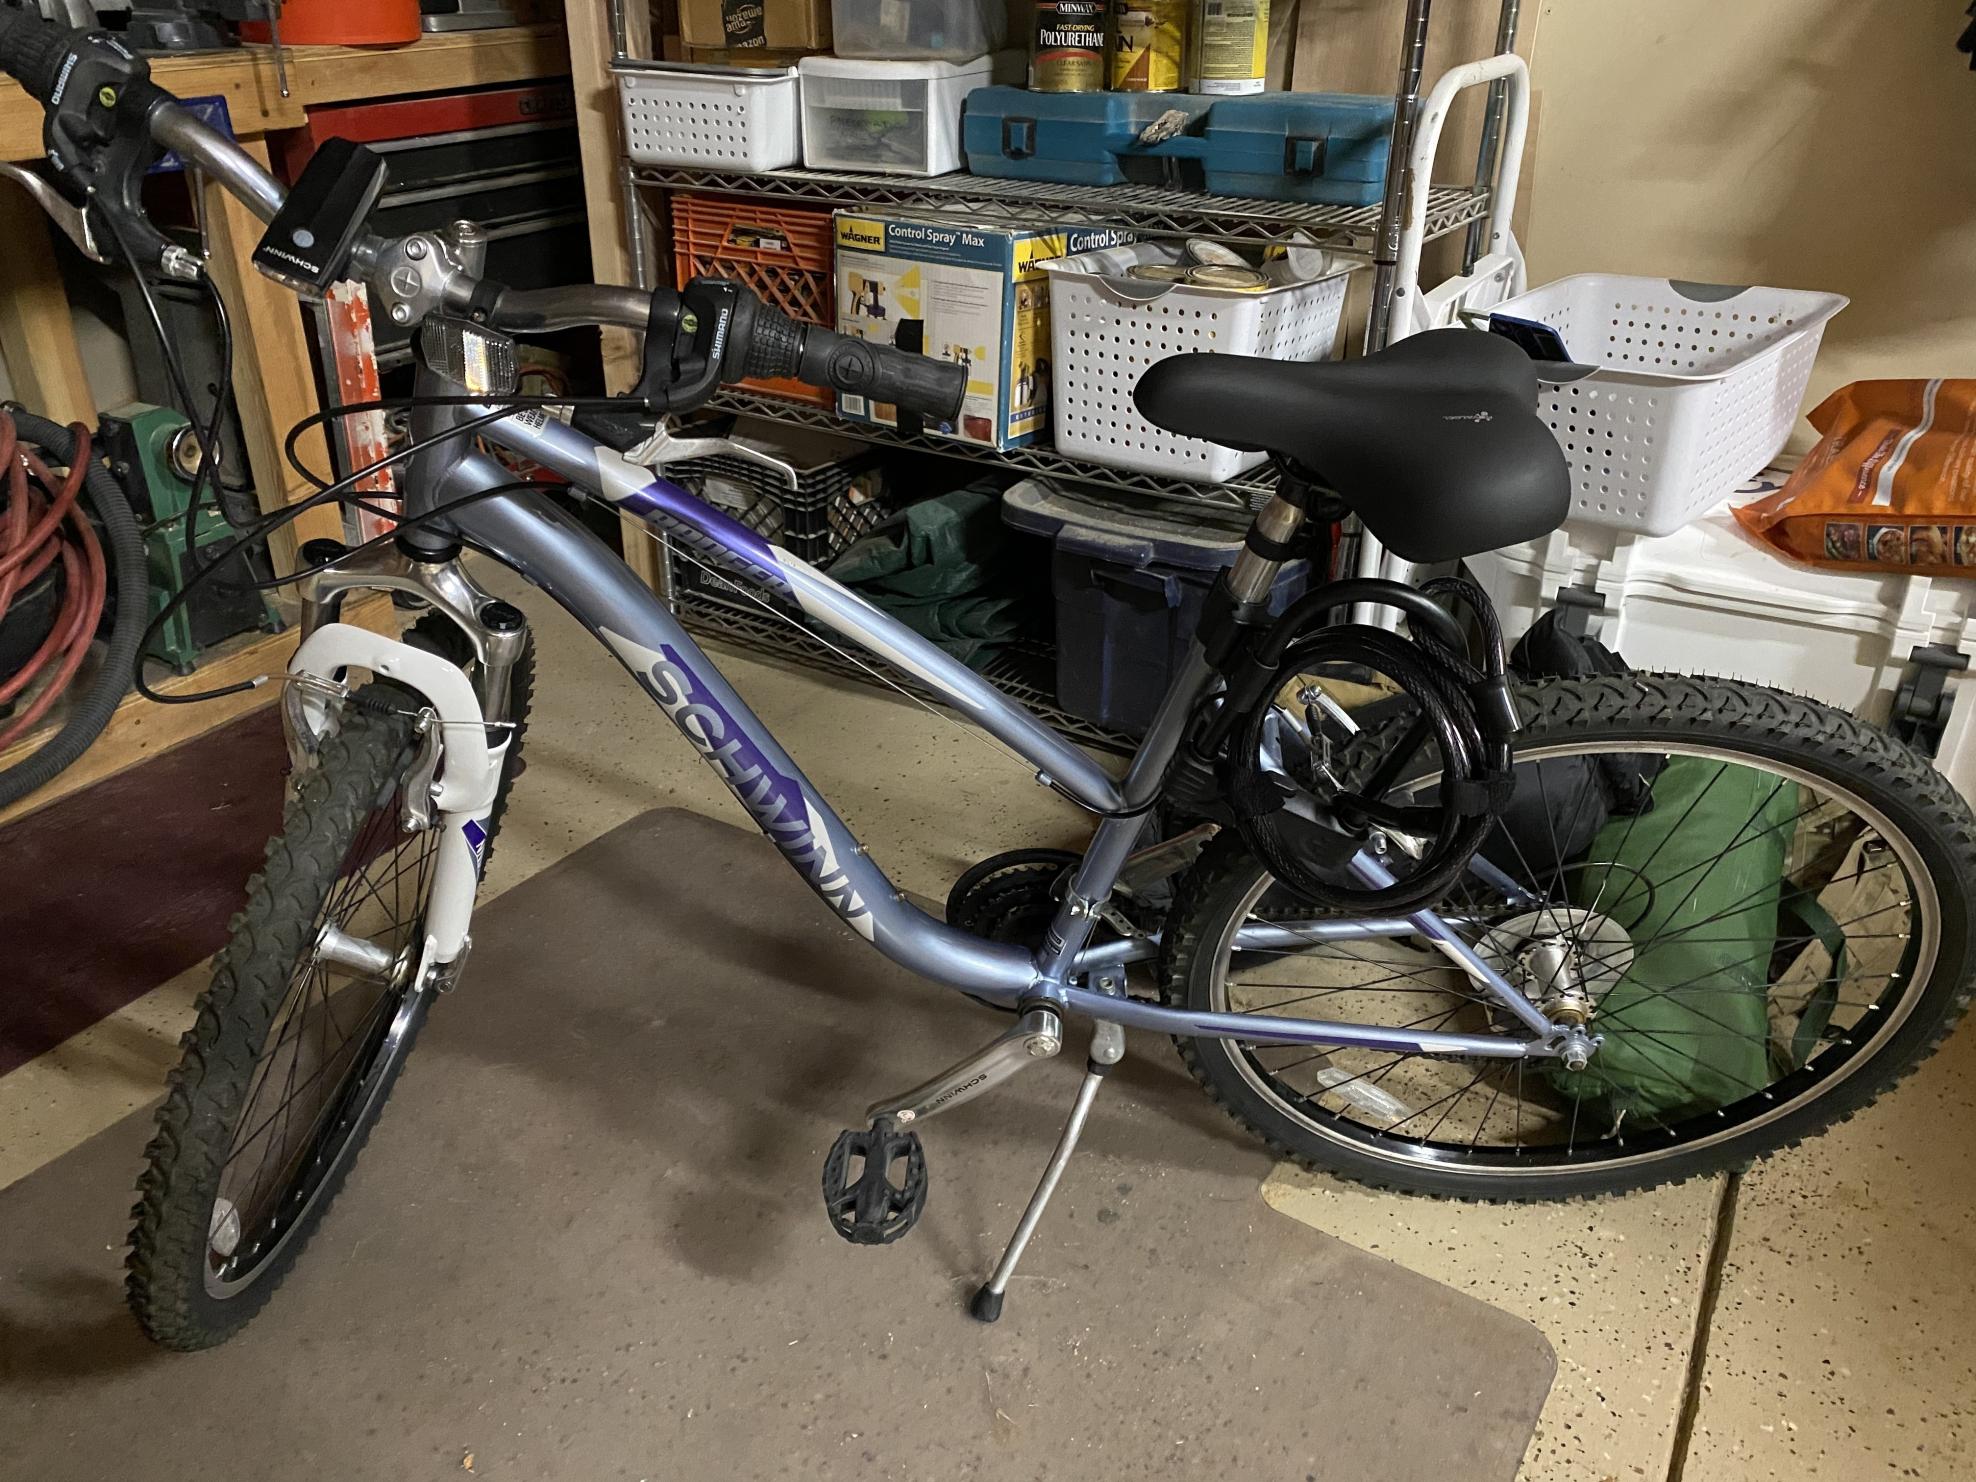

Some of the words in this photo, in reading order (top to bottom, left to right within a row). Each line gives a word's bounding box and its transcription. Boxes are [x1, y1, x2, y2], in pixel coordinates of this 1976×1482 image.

[1059, 3, 1094, 13] MINWAX
[1056, 24, 1095, 32] FAST-DRYING
[51, 52, 78, 105] SHIMANO
[840, 231, 881, 246] WAGNER
[888, 224, 925, 240] Control
[961, 233, 985, 247] Max
[1070, 229, 1109, 252] Control
[263, 246, 320, 274] SCHWINN
[712, 308, 729, 360] SHIMANO
[635, 658, 868, 922] SCHWINN
[935, 1073, 988, 1105] SCHWINN
